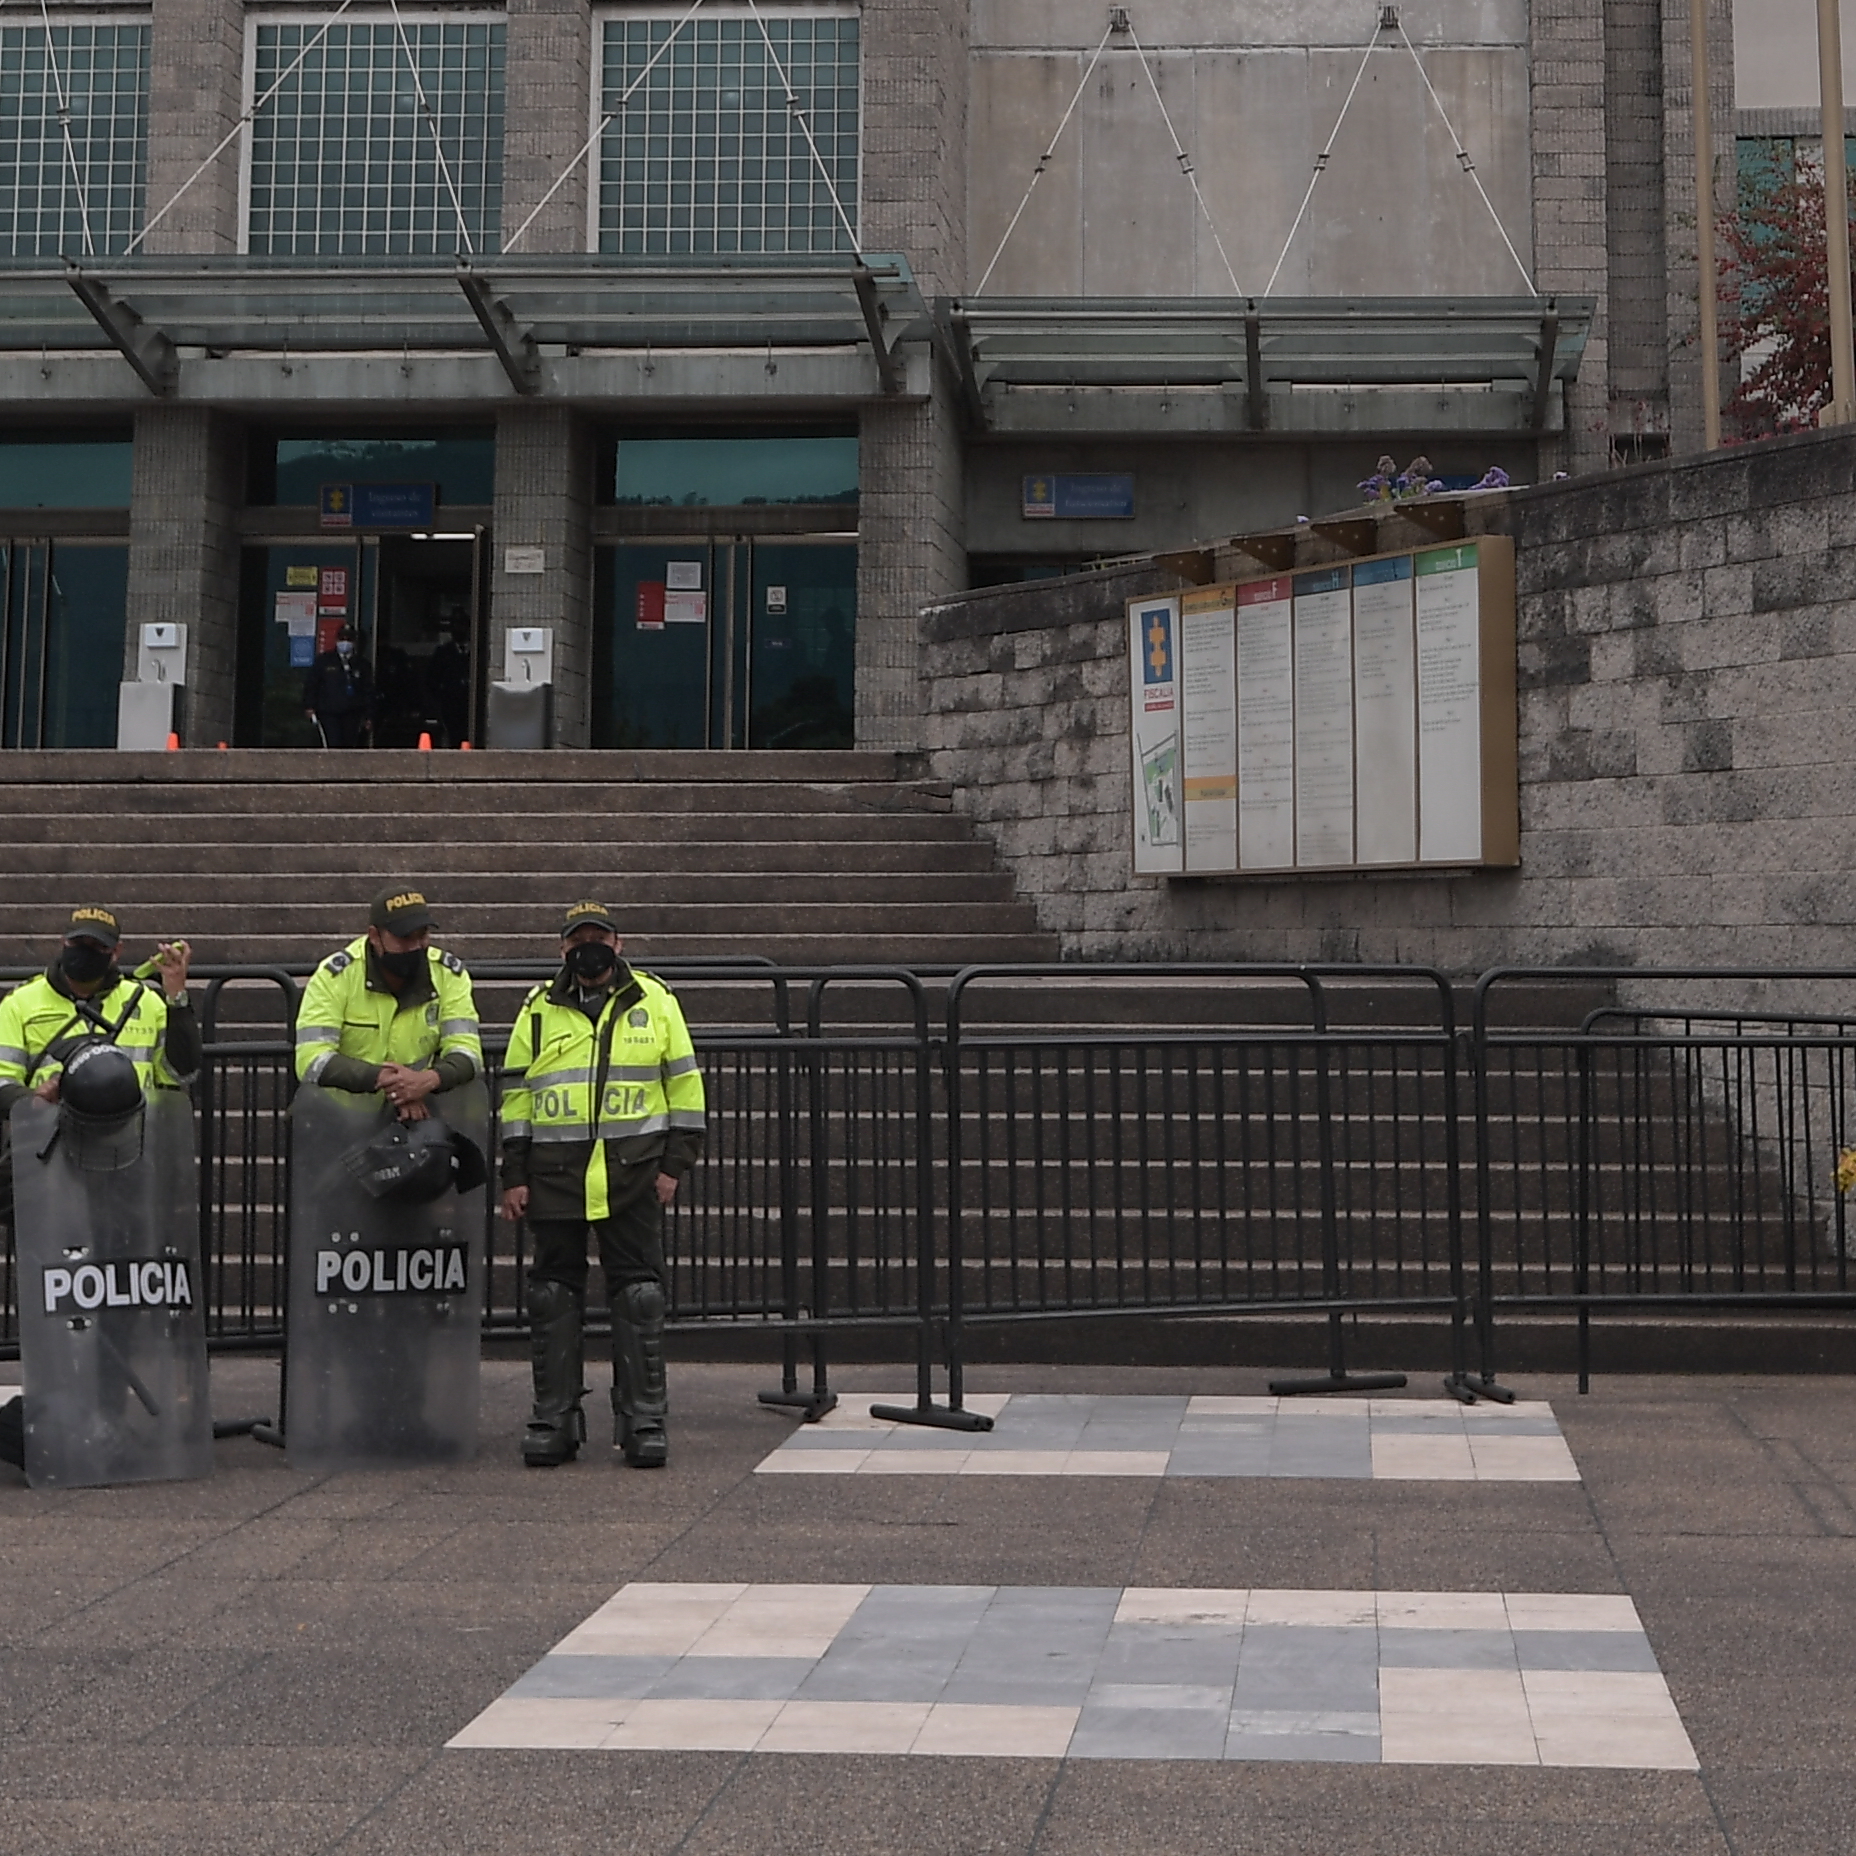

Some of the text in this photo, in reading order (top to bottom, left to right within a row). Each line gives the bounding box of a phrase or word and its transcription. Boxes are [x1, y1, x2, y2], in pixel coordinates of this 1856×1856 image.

[535, 1087, 648, 1119] POLCIA
[43, 1261, 192, 1312] POLICIA
[316, 1248, 466, 1293] POLICIA
